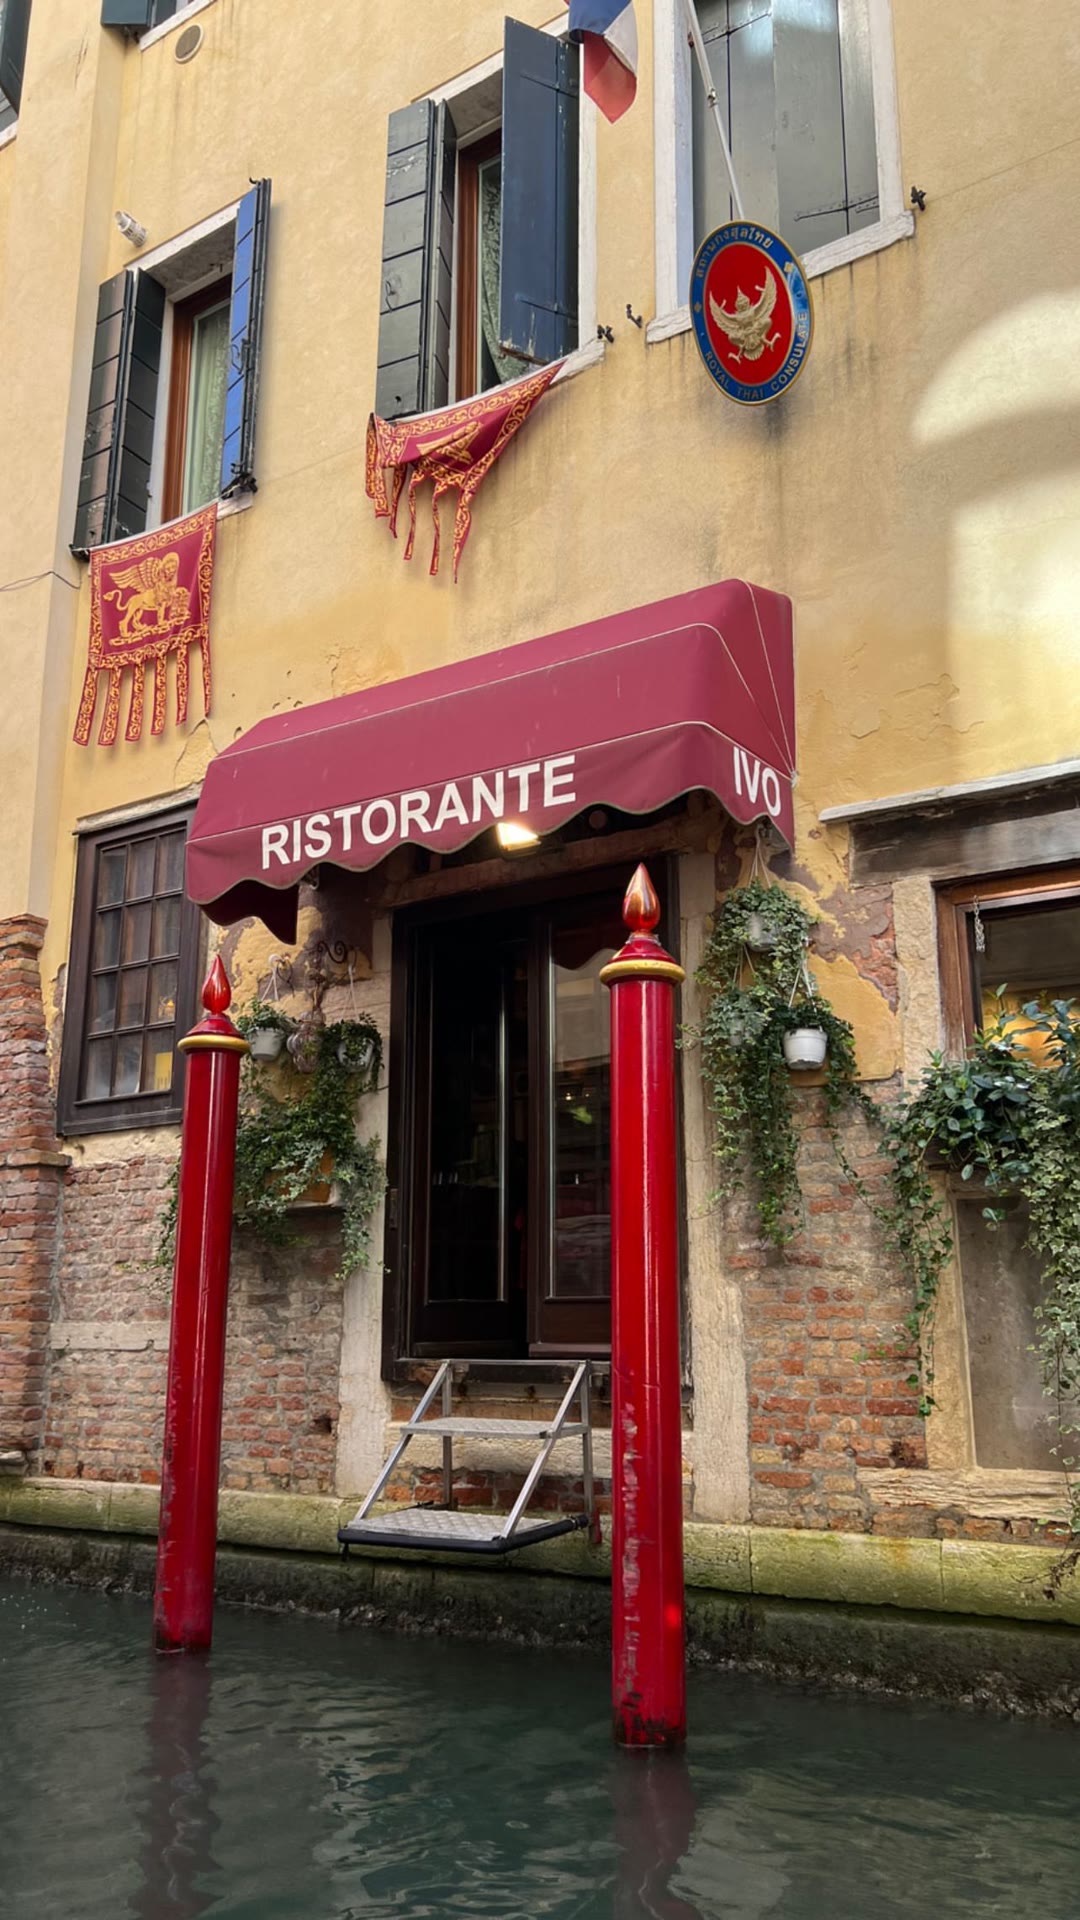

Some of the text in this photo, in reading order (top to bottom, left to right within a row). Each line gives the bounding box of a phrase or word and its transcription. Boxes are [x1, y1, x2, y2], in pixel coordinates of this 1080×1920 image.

[705, 312, 808, 400] ROYAL THAI CONSULATE
[262, 755, 577, 870] RISTORANTE
[732, 747, 782, 816] IVO
